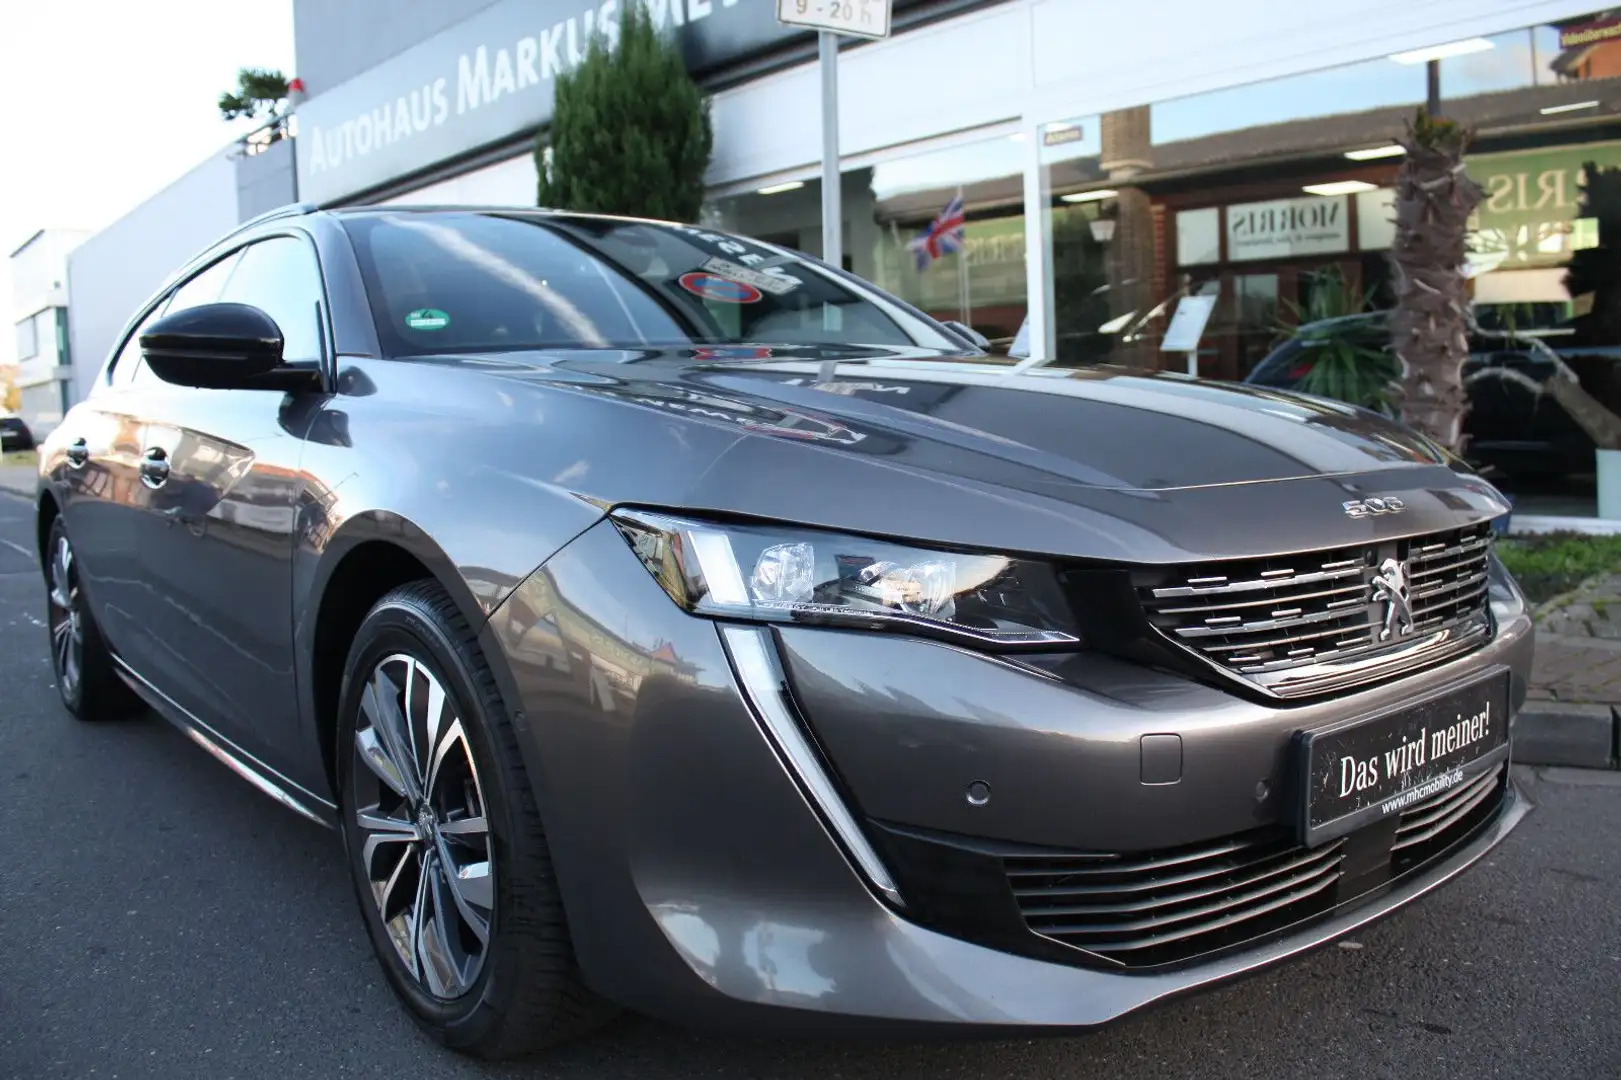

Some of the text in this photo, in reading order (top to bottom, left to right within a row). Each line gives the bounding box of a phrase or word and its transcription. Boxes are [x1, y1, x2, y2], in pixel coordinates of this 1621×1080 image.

[829, 1, 853, 21] 20
[309, 0, 620, 177] AUTOHAUS MARKUS
[1339, 701, 1490, 798] Das wird meiner!
[1381, 768, 1464, 815] www.mhcmobility.de
